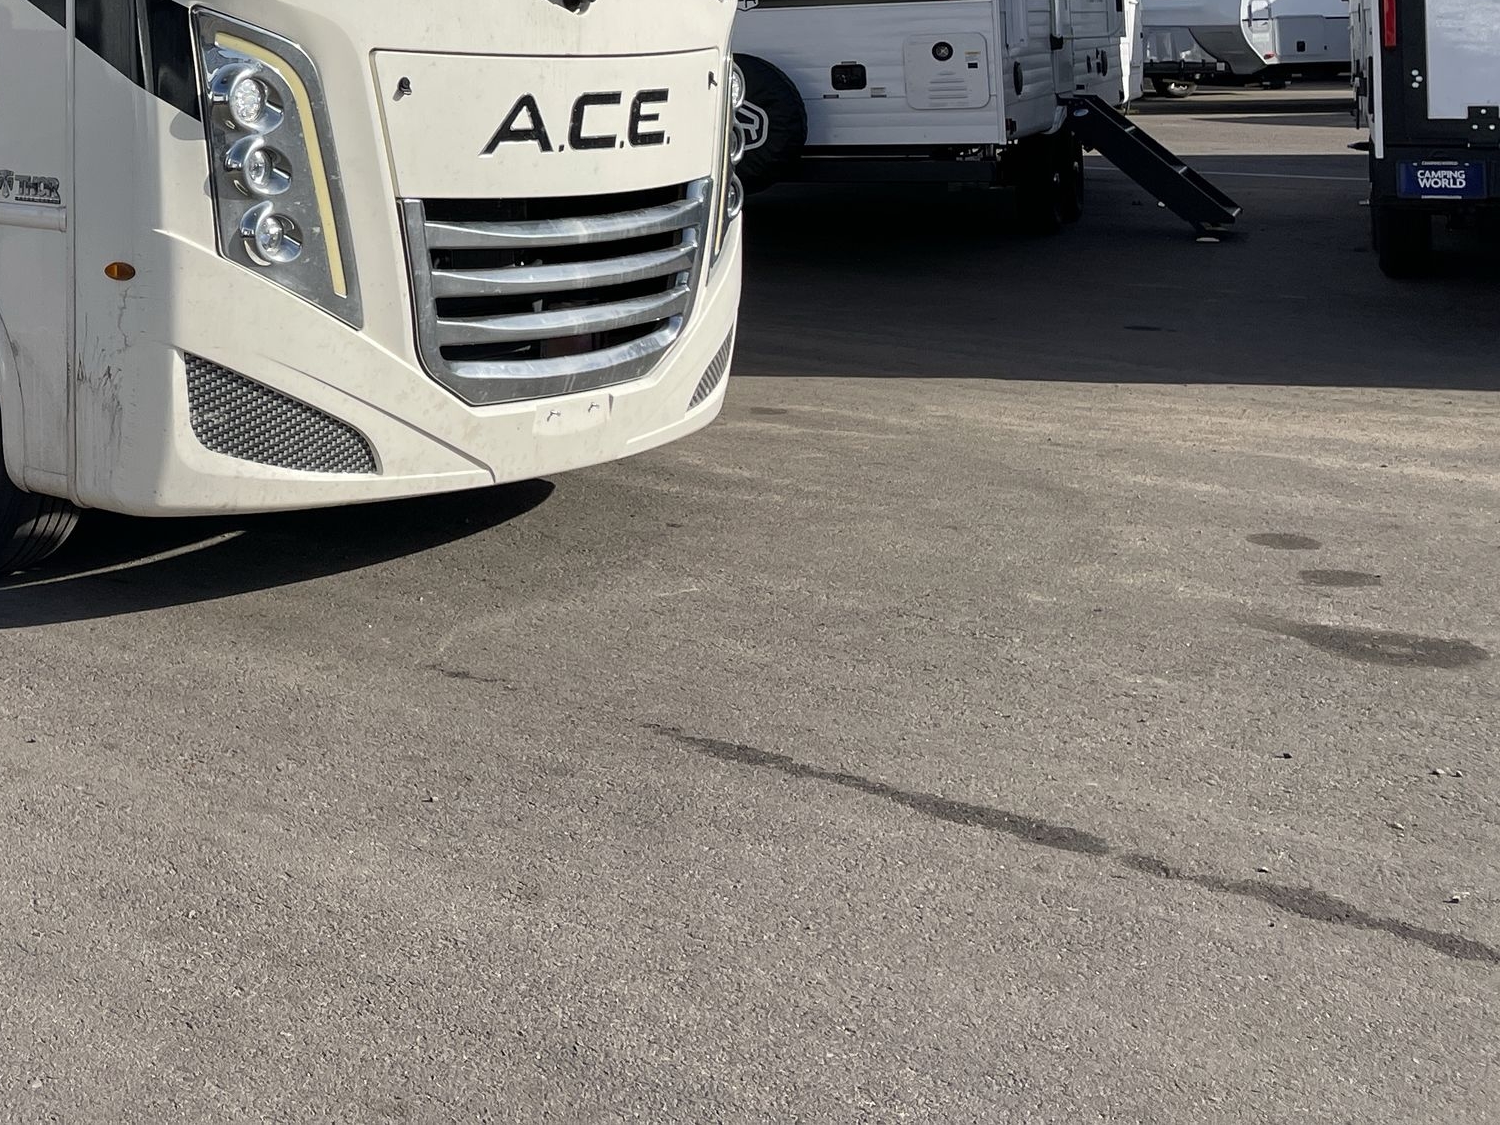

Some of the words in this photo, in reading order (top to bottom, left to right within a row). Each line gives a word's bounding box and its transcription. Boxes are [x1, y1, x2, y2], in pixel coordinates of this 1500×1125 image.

[478, 88, 671, 156] A.C.E.
[1417, 170, 1466, 179] CAMPING
[1418, 178, 1467, 189] WORLD
[14, 174, 61, 199] THOR
